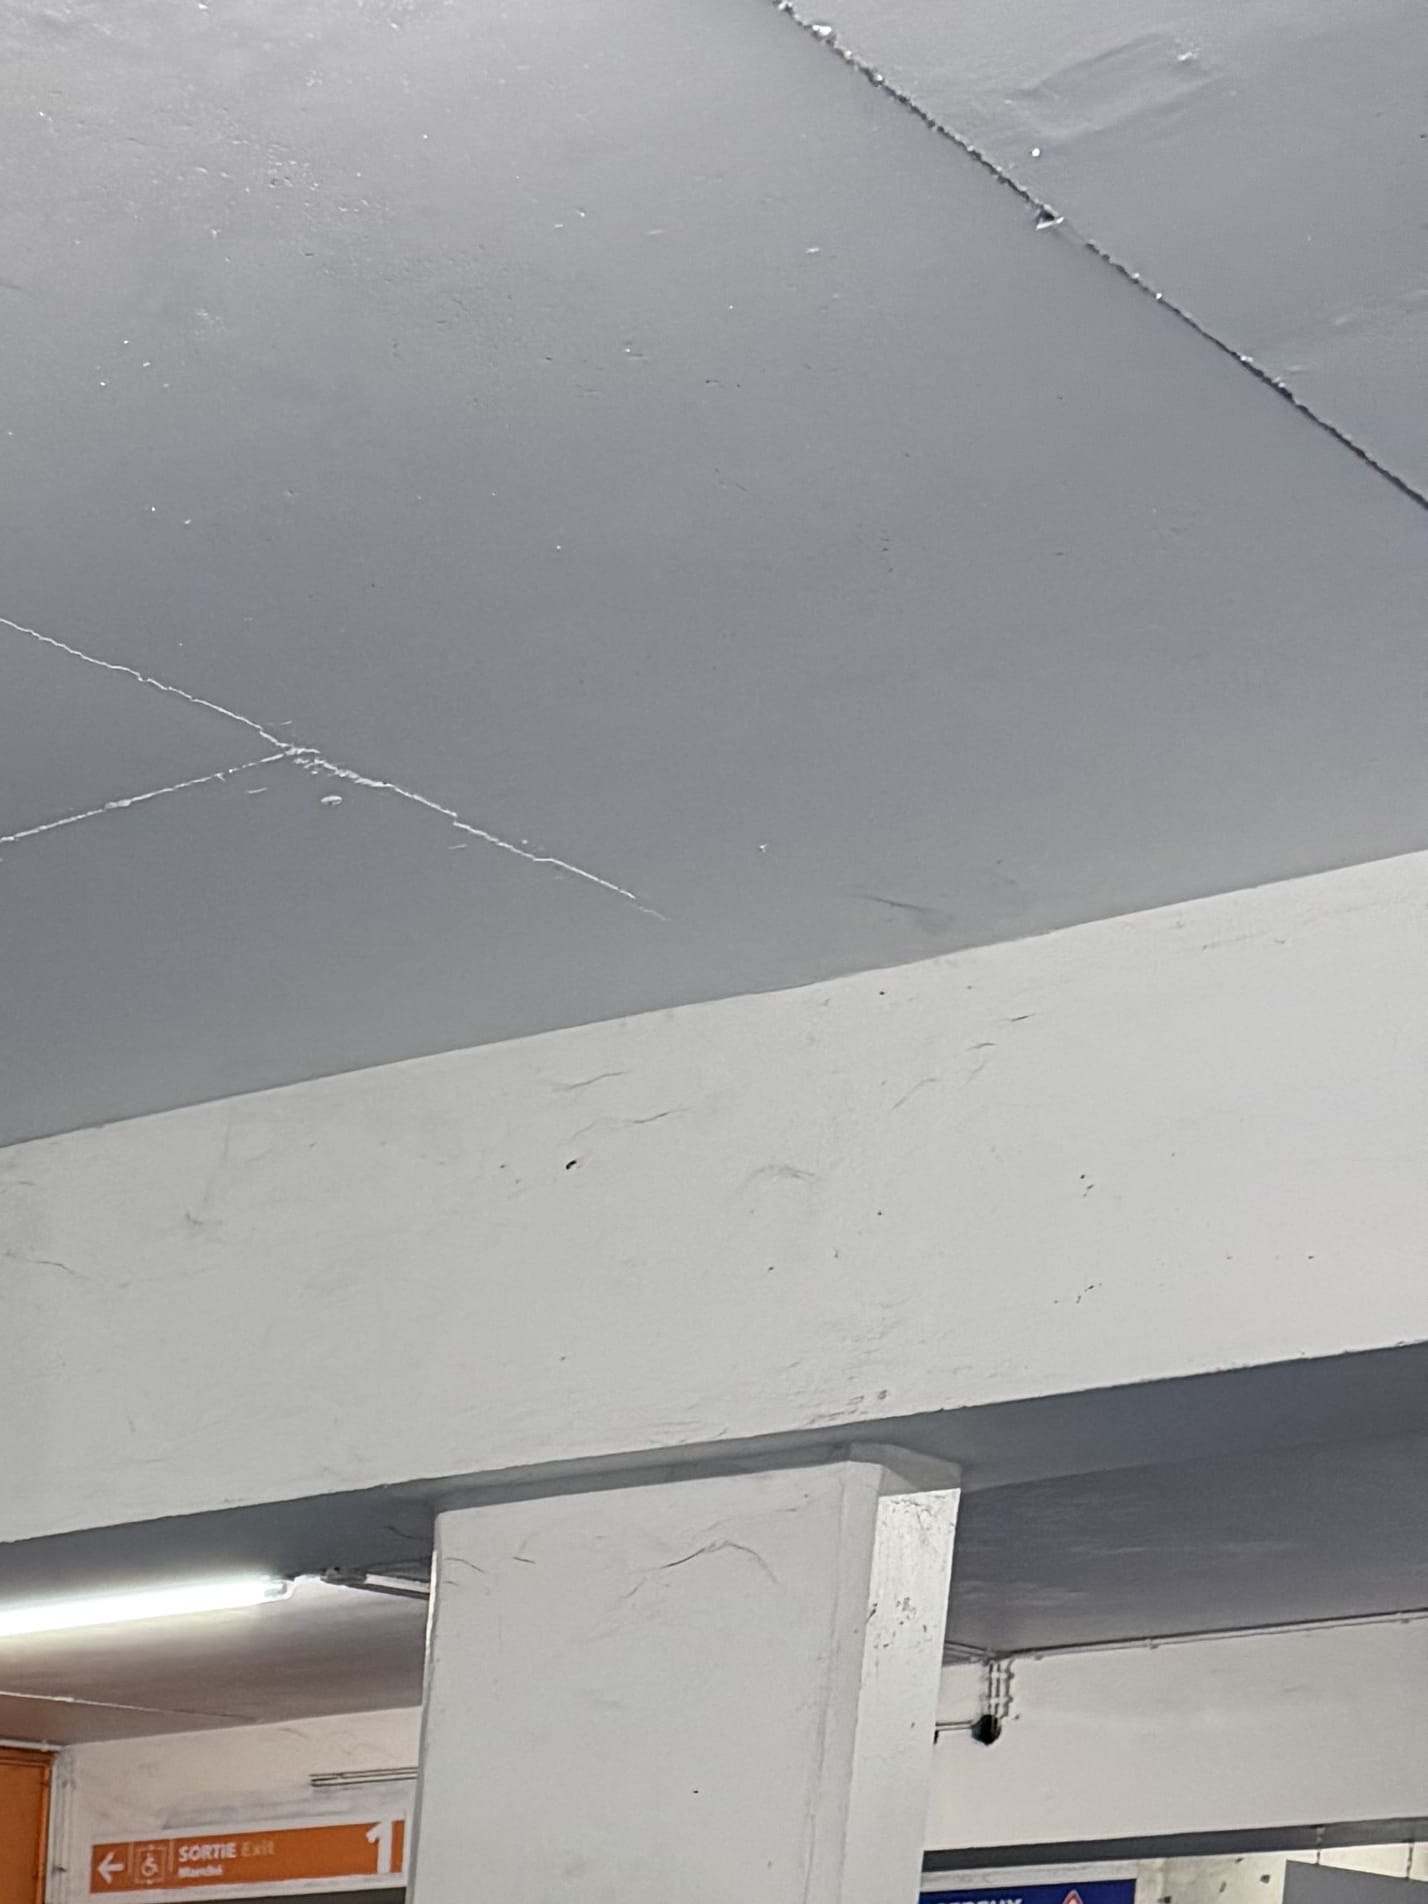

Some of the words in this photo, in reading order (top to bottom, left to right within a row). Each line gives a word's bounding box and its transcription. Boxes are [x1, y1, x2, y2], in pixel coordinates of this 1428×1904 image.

[178, 1842, 237, 1862] SORTIE
[241, 1840, 275, 1857] Exit
[366, 1820, 393, 1874] 1
